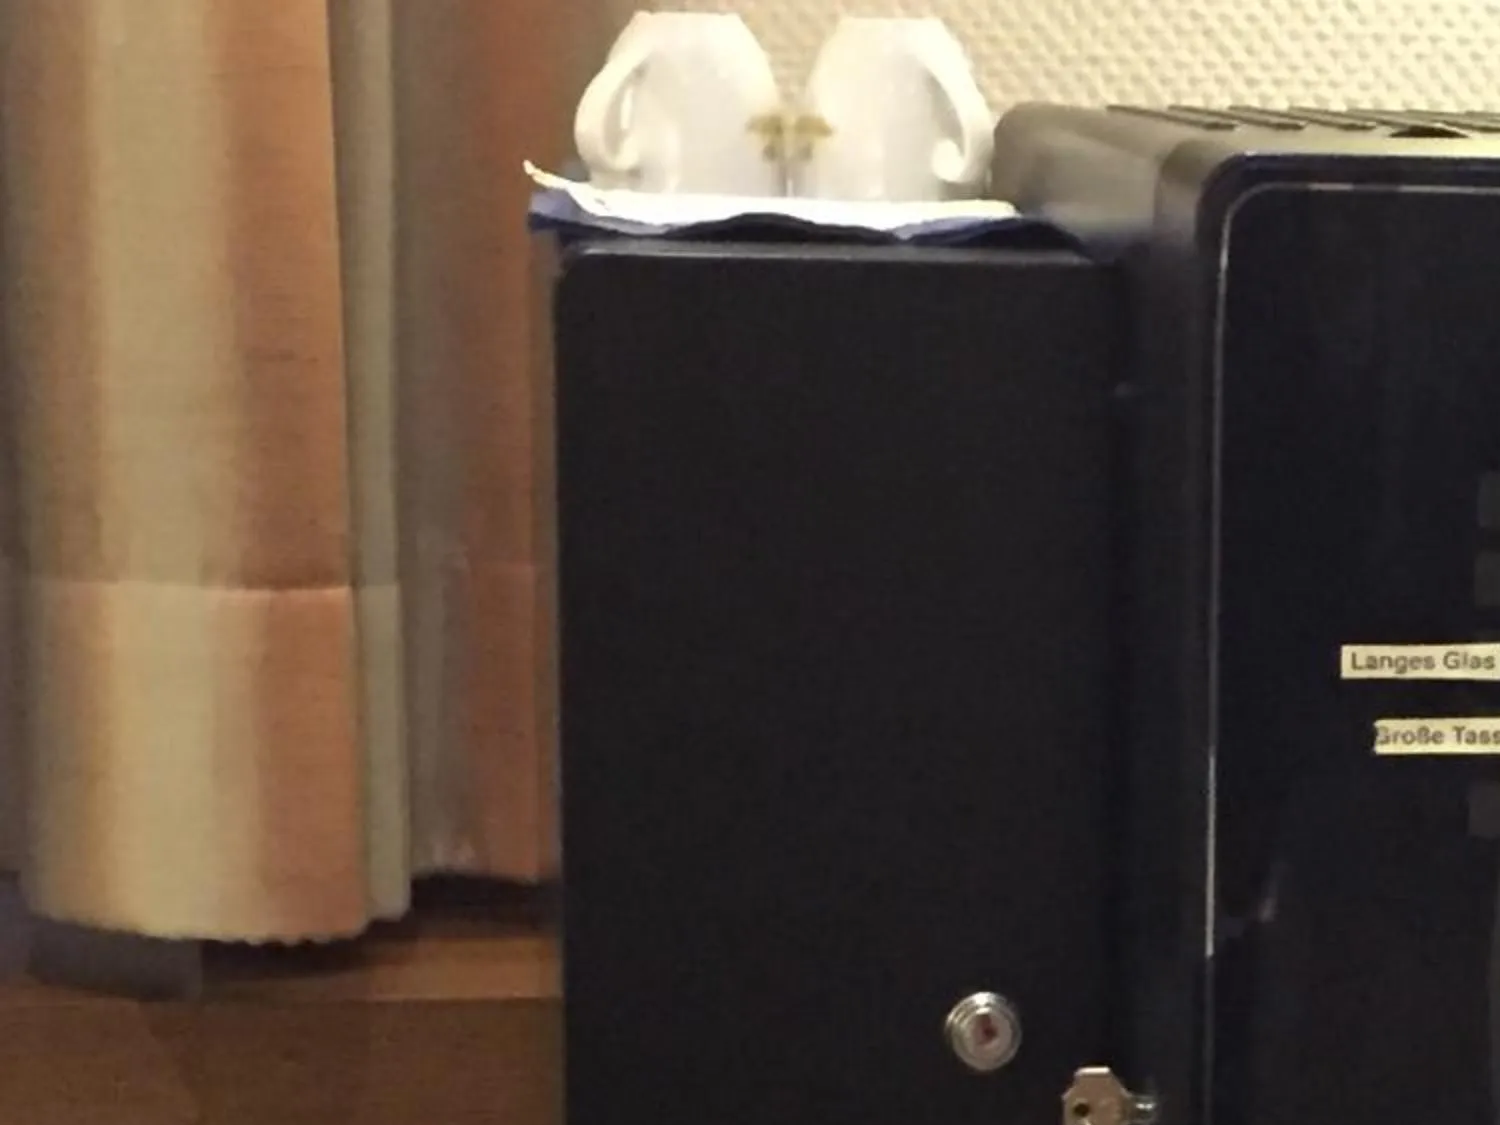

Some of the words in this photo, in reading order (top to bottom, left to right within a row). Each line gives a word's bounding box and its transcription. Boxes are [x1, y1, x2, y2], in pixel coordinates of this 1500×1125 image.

[1350, 651, 1436, 675] Langes
[1443, 651, 1496, 670] Glas
[1376, 724, 1445, 745] Große
